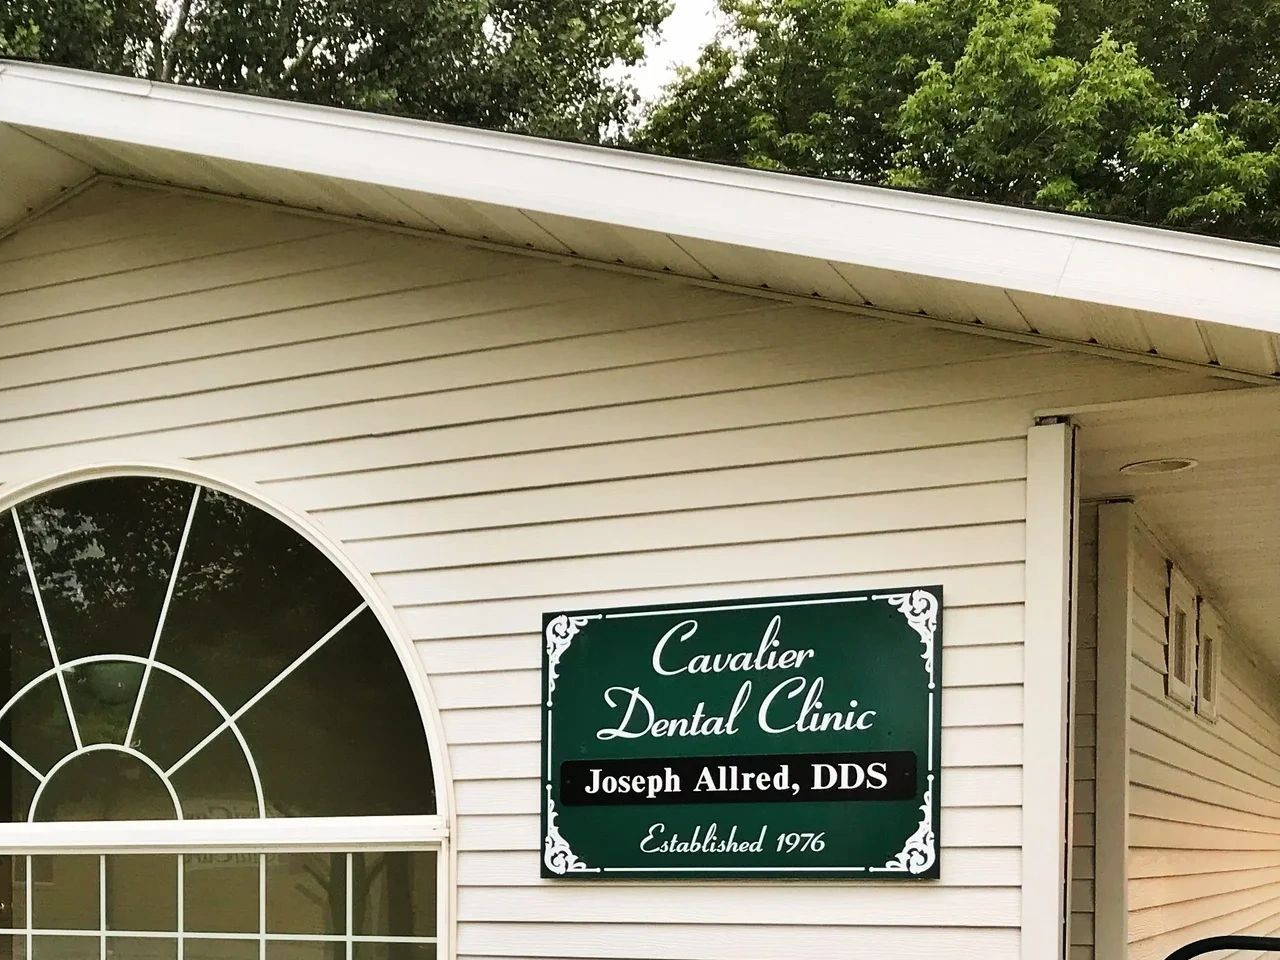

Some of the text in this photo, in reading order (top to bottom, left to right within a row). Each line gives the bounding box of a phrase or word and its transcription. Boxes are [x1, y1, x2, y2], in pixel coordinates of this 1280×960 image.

[652, 615, 815, 676] Cavalier
[596, 676, 877, 741] Dental Clinic
[584, 762, 888, 799] Joseph Allred, DDS
[639, 823, 826, 854] Established 1976
